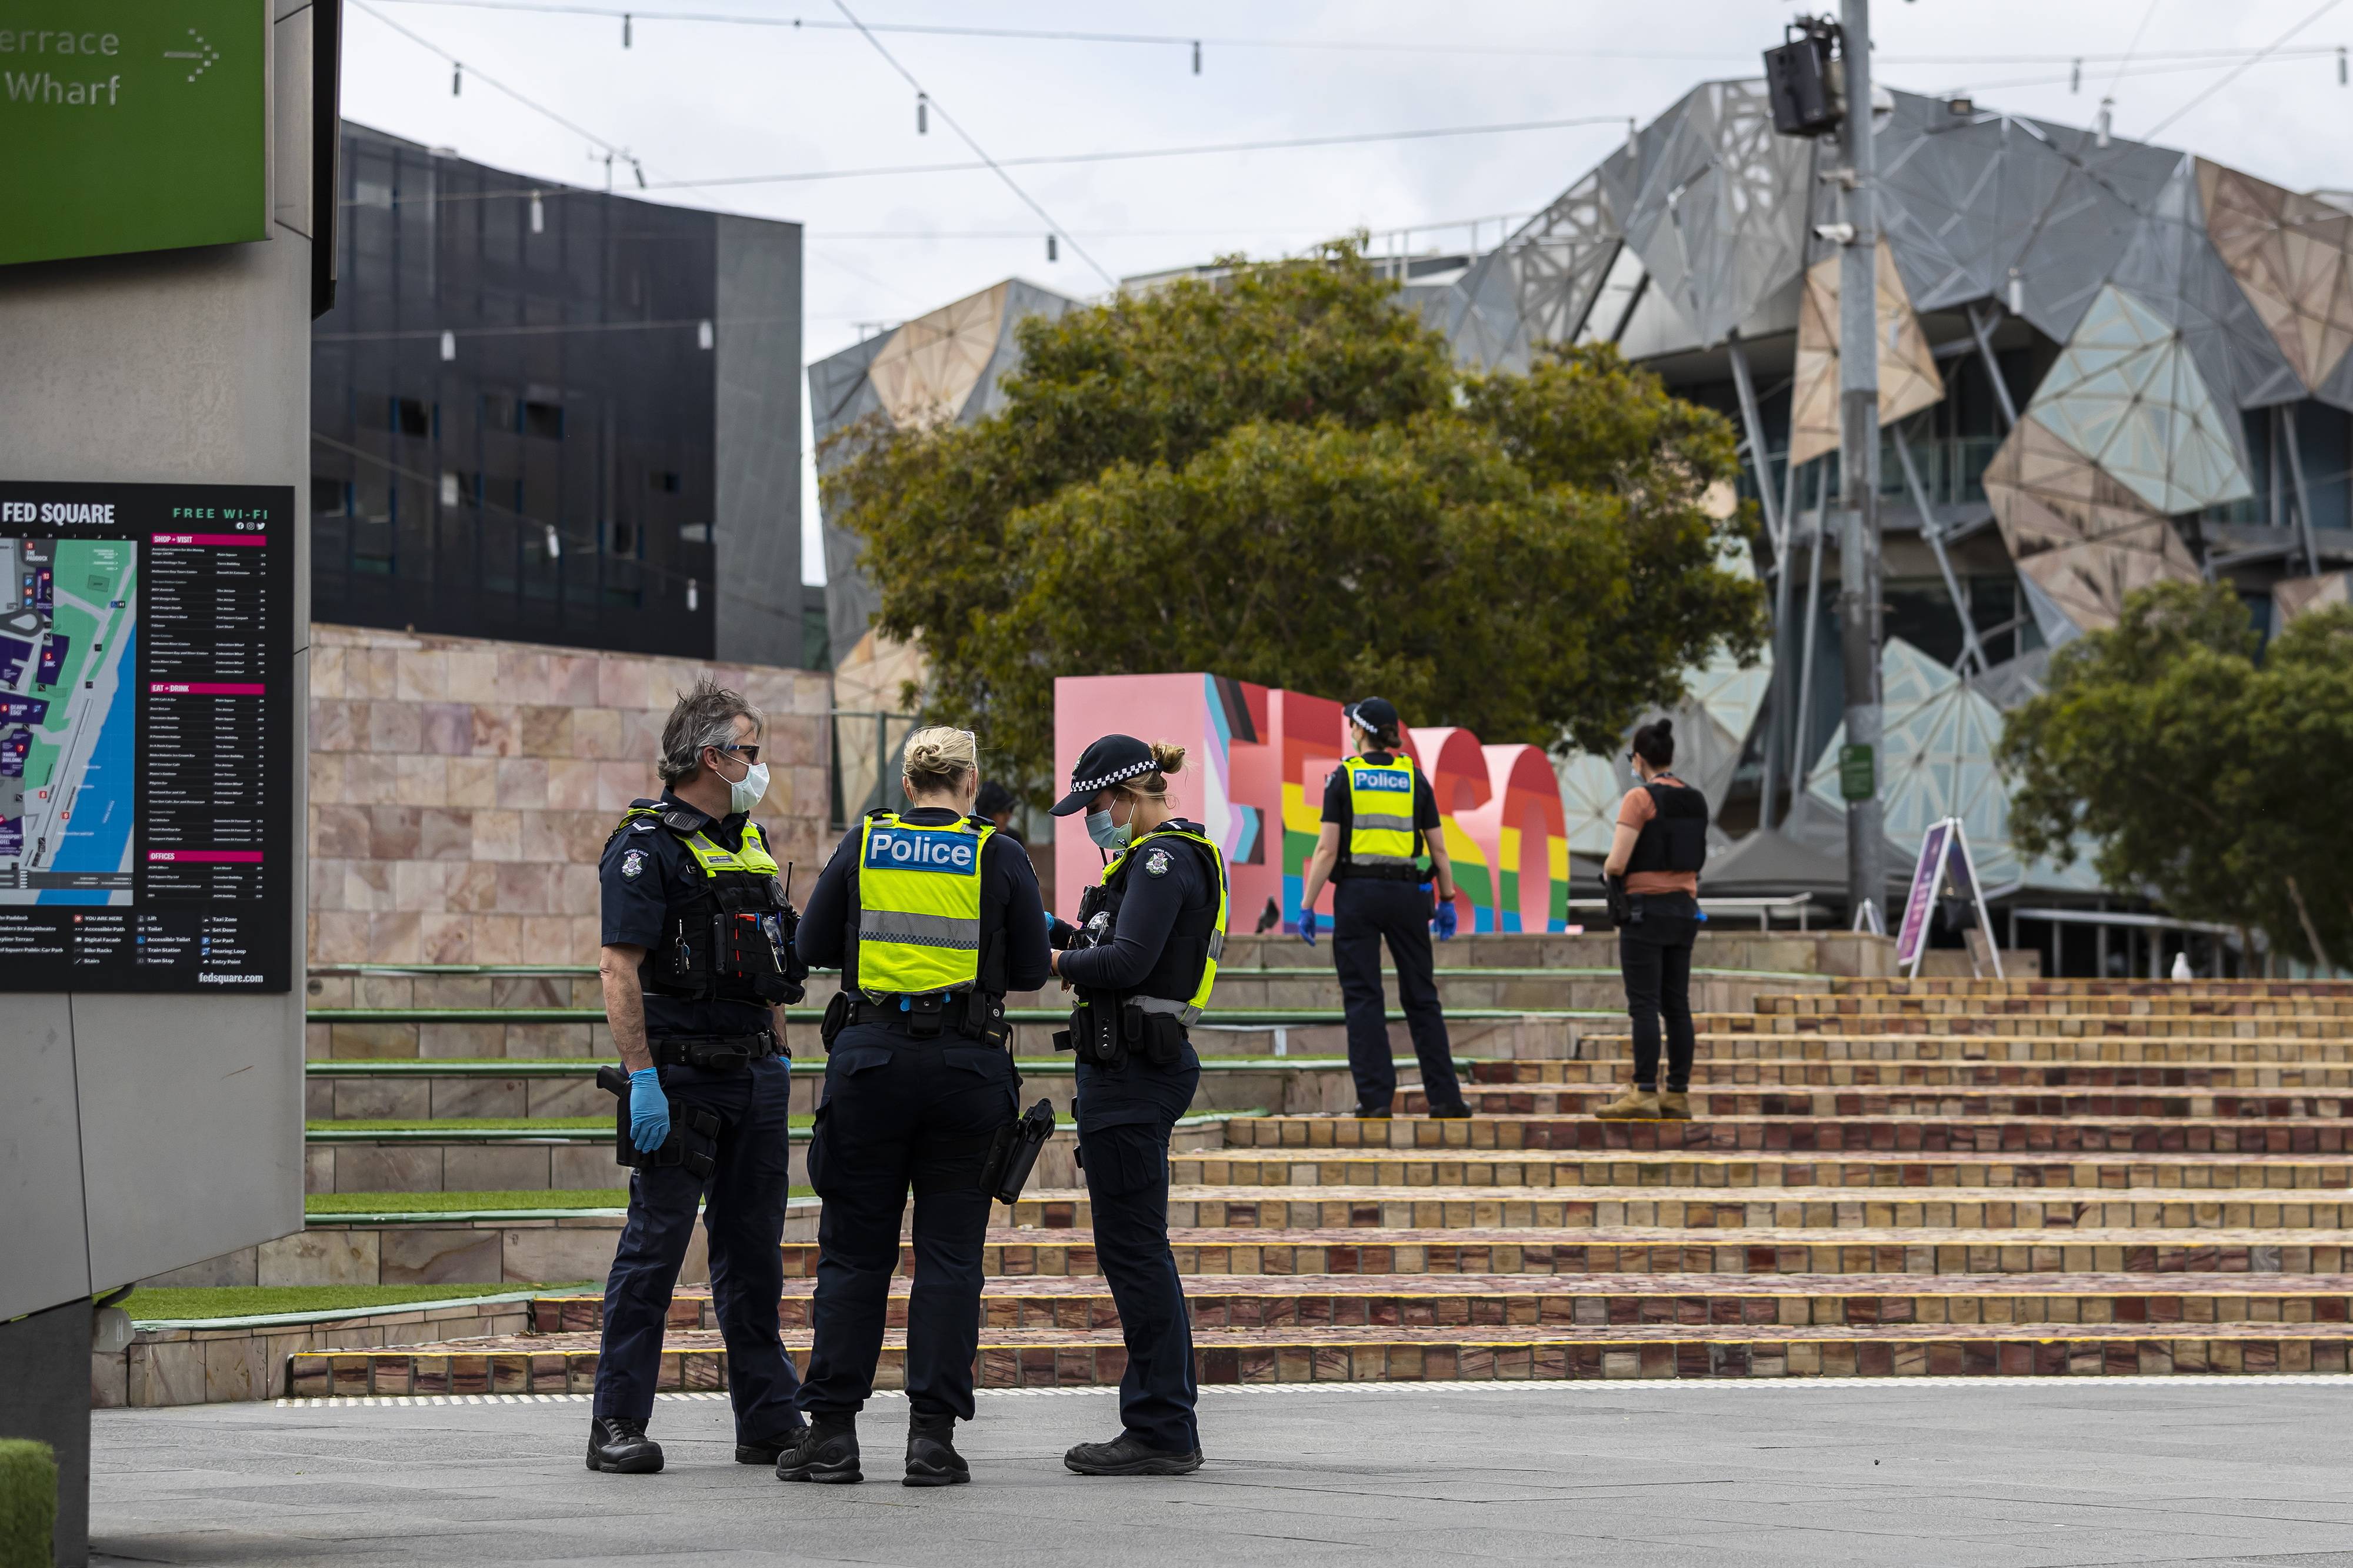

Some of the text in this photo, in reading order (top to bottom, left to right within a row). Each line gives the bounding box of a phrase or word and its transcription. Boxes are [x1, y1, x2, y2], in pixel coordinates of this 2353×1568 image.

[5, 71, 121, 106] Wharf
[3, 502, 115, 526] FED SQUARE
[172, 507, 268, 520] FREE WI-FI
[152, 684, 165, 692] EAT
[1355, 772, 1409, 789] Police
[150, 852, 175, 860] OFFICES
[870, 834, 972, 866] Police
[1165, 852, 1175, 860] POLICE
[199, 972, 264, 985] fedsquare.com
